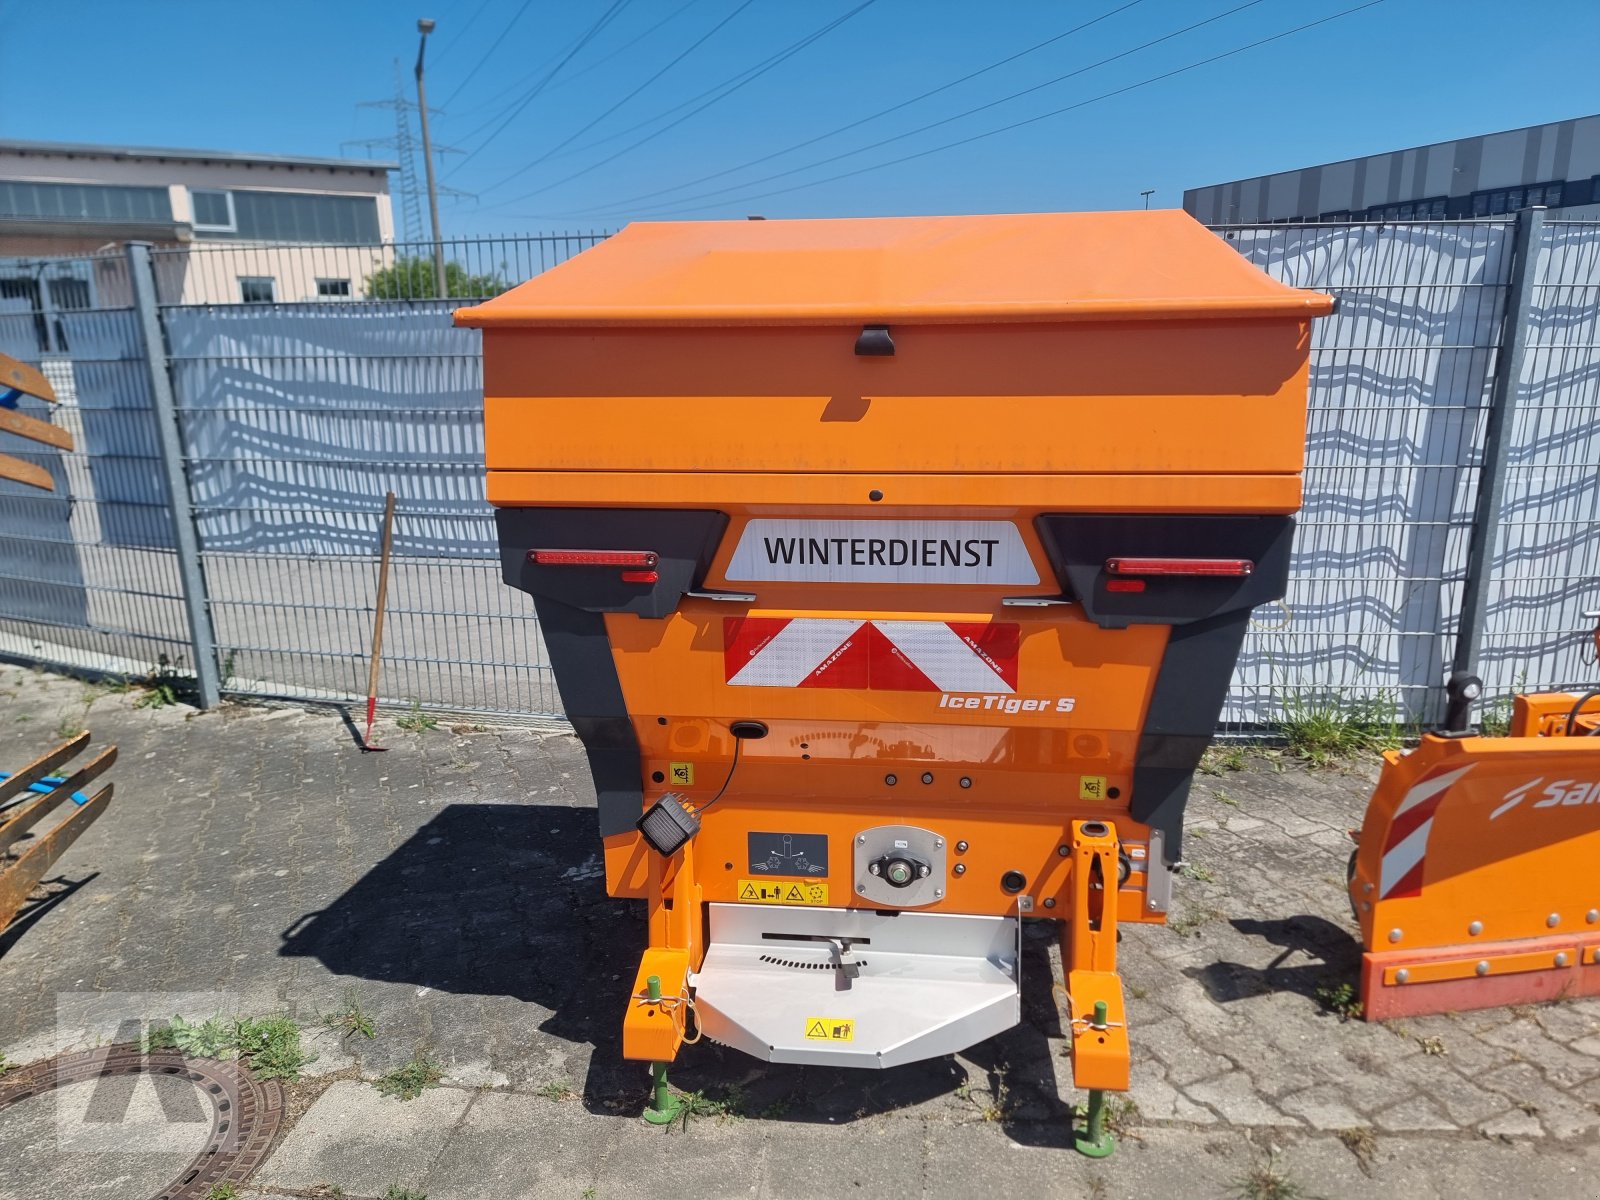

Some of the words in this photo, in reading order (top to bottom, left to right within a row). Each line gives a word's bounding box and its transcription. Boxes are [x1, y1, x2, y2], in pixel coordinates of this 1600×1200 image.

[764, 537, 1000, 567] WINTERDIENST
[815, 640, 853, 676] AMAZONE
[964, 636, 1003, 674] AMAZONE
[939, 694, 1051, 713] IceTiger
[1056, 698, 1075, 712] S
